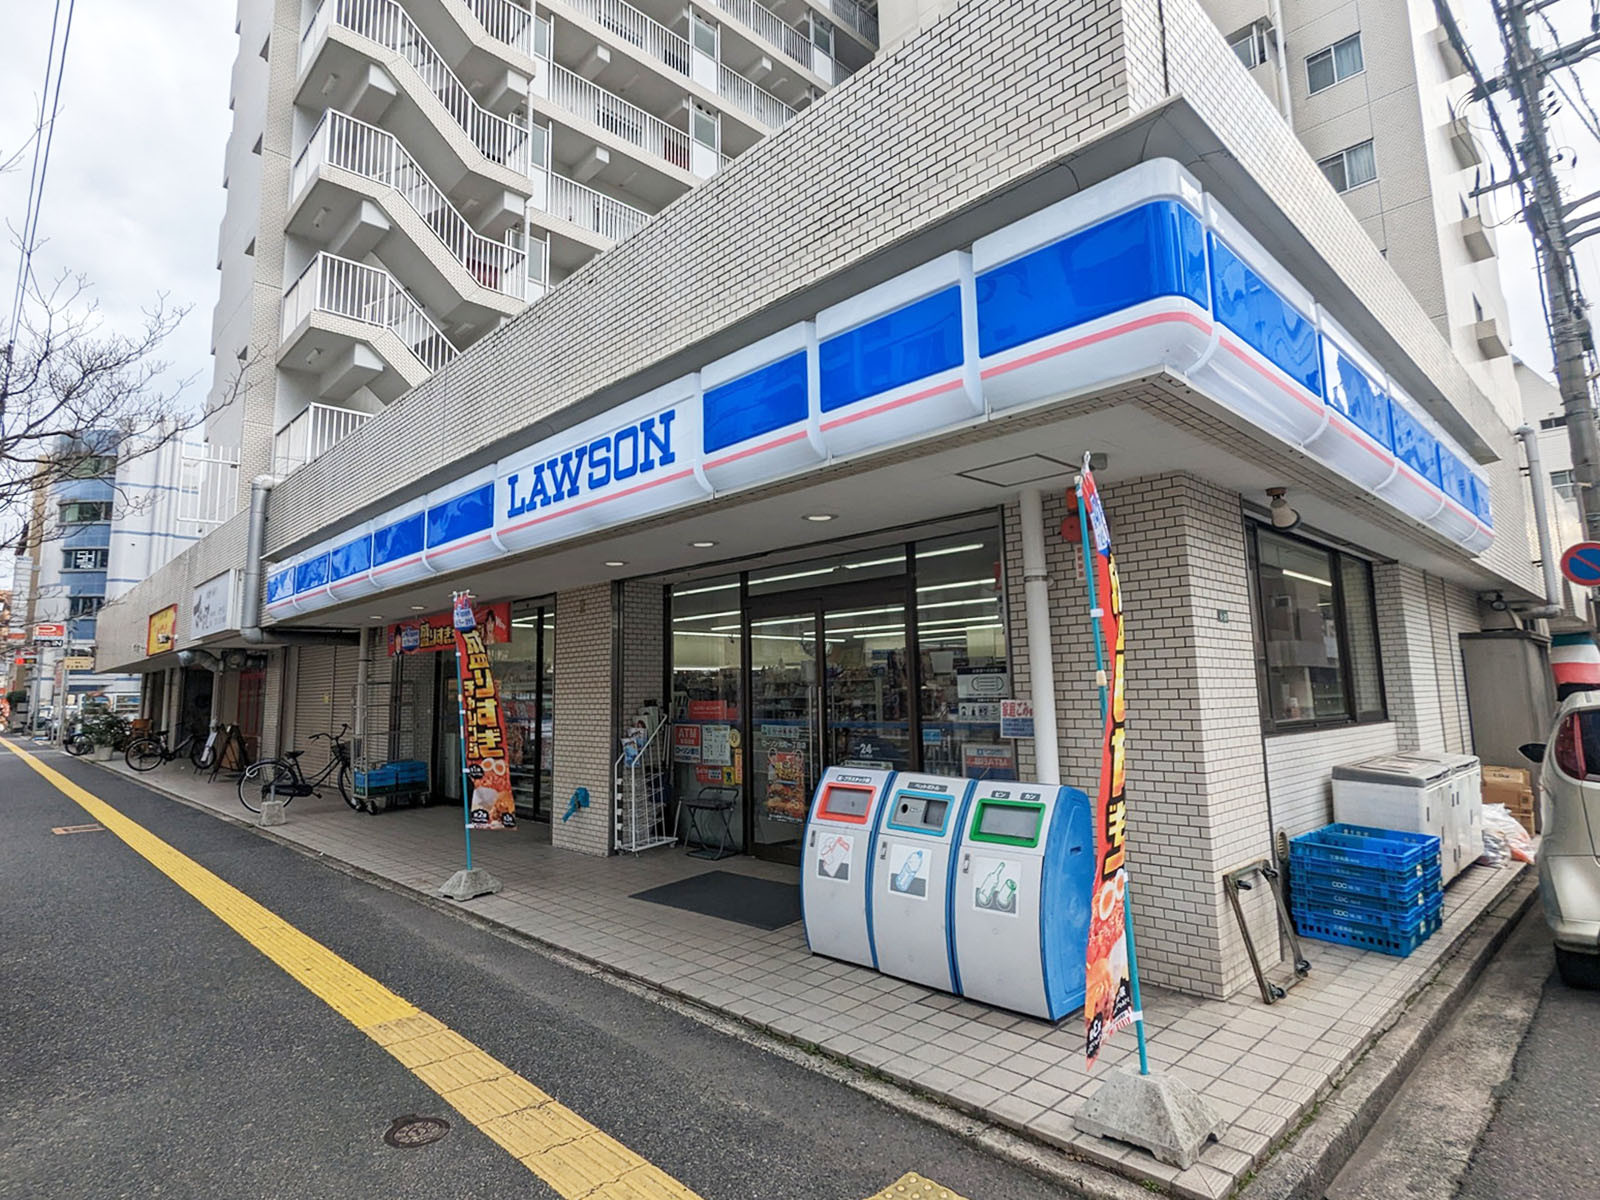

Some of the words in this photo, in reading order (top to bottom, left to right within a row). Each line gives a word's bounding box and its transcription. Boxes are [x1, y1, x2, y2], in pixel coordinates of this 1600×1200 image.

[507, 408, 676, 519] LAWSON
[463, 630, 504, 758] 盛りすぎ
[463, 679, 480, 759] チャレンジ
[678, 727, 698, 739] ATM
[860, 743, 873, 754] 24
